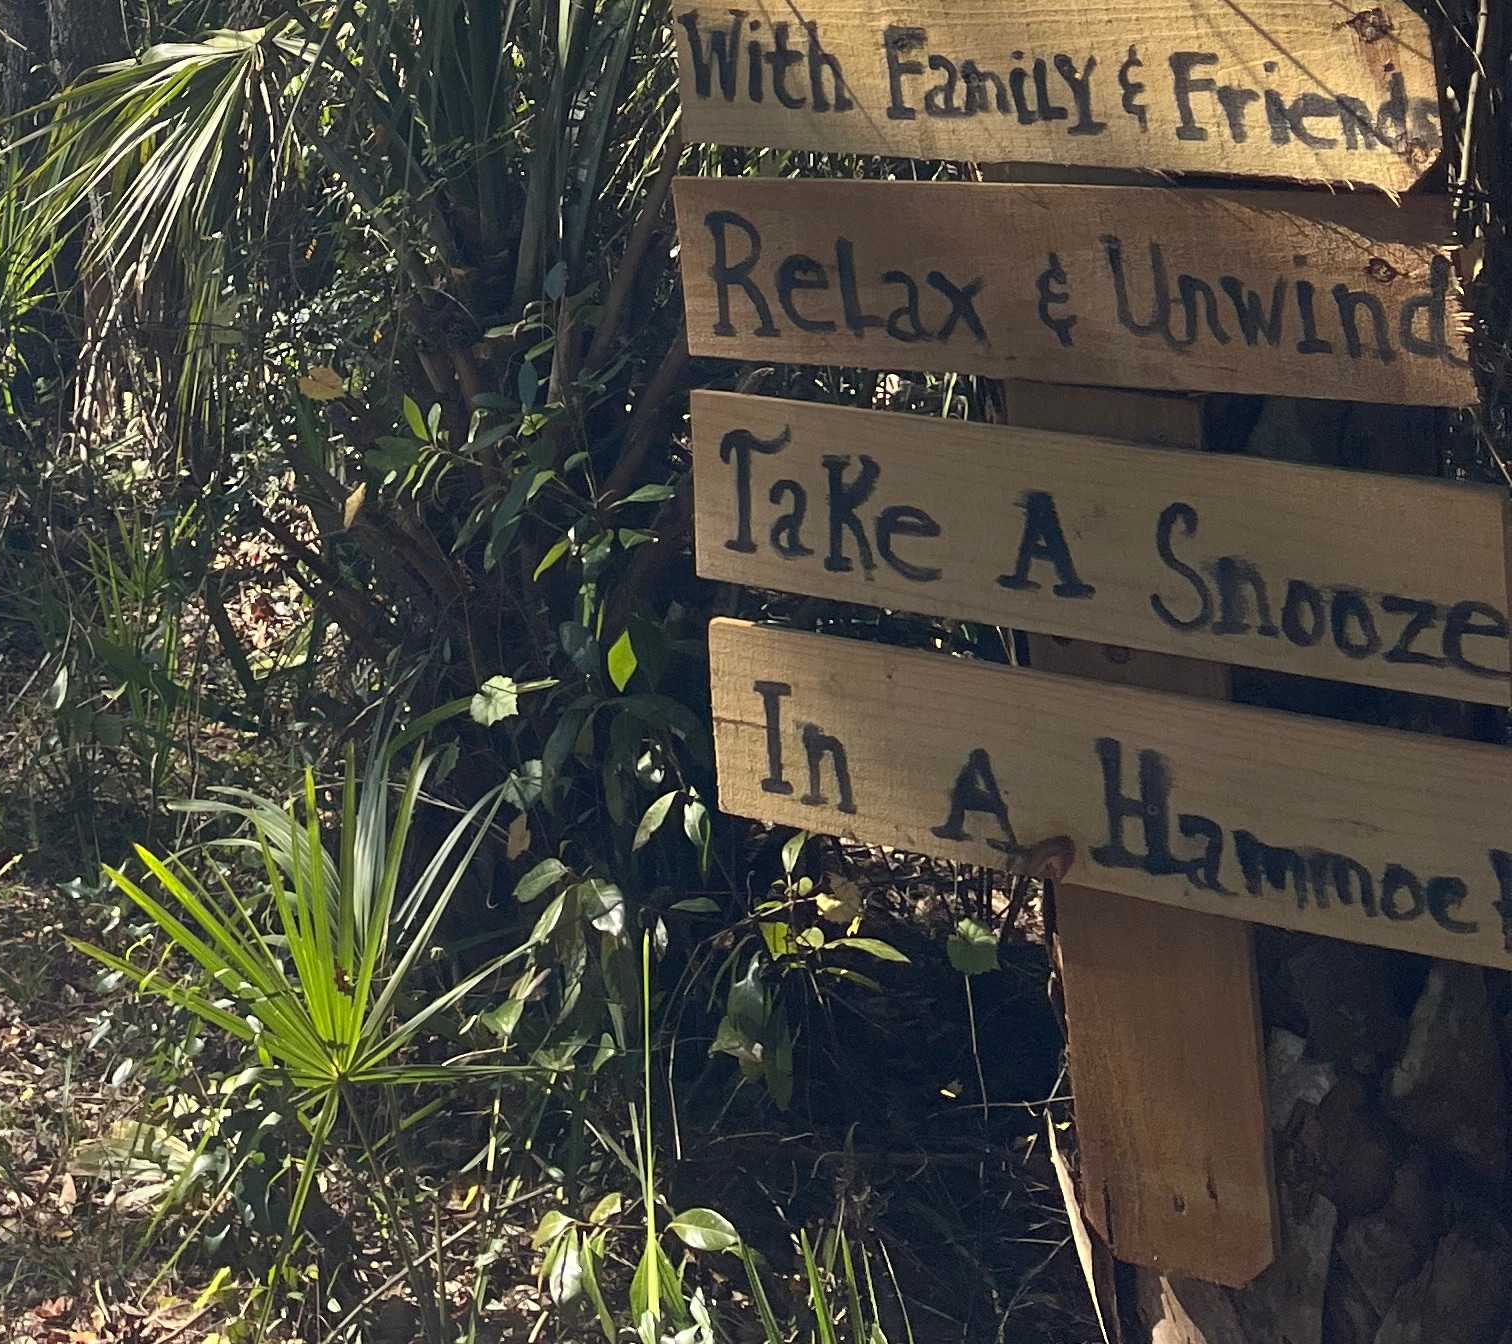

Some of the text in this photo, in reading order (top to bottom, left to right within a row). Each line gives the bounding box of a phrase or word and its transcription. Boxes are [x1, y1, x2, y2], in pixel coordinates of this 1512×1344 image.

[678, 9, 855, 113] With
[1118, 44, 1149, 130] &
[1038, 251, 1080, 348] &
[1098, 233, 1470, 368] Unwind
[996, 490, 1096, 599] A
[1149, 502, 1512, 680] Snooze
[752, 679, 858, 815] In
[931, 747, 1020, 854] A
